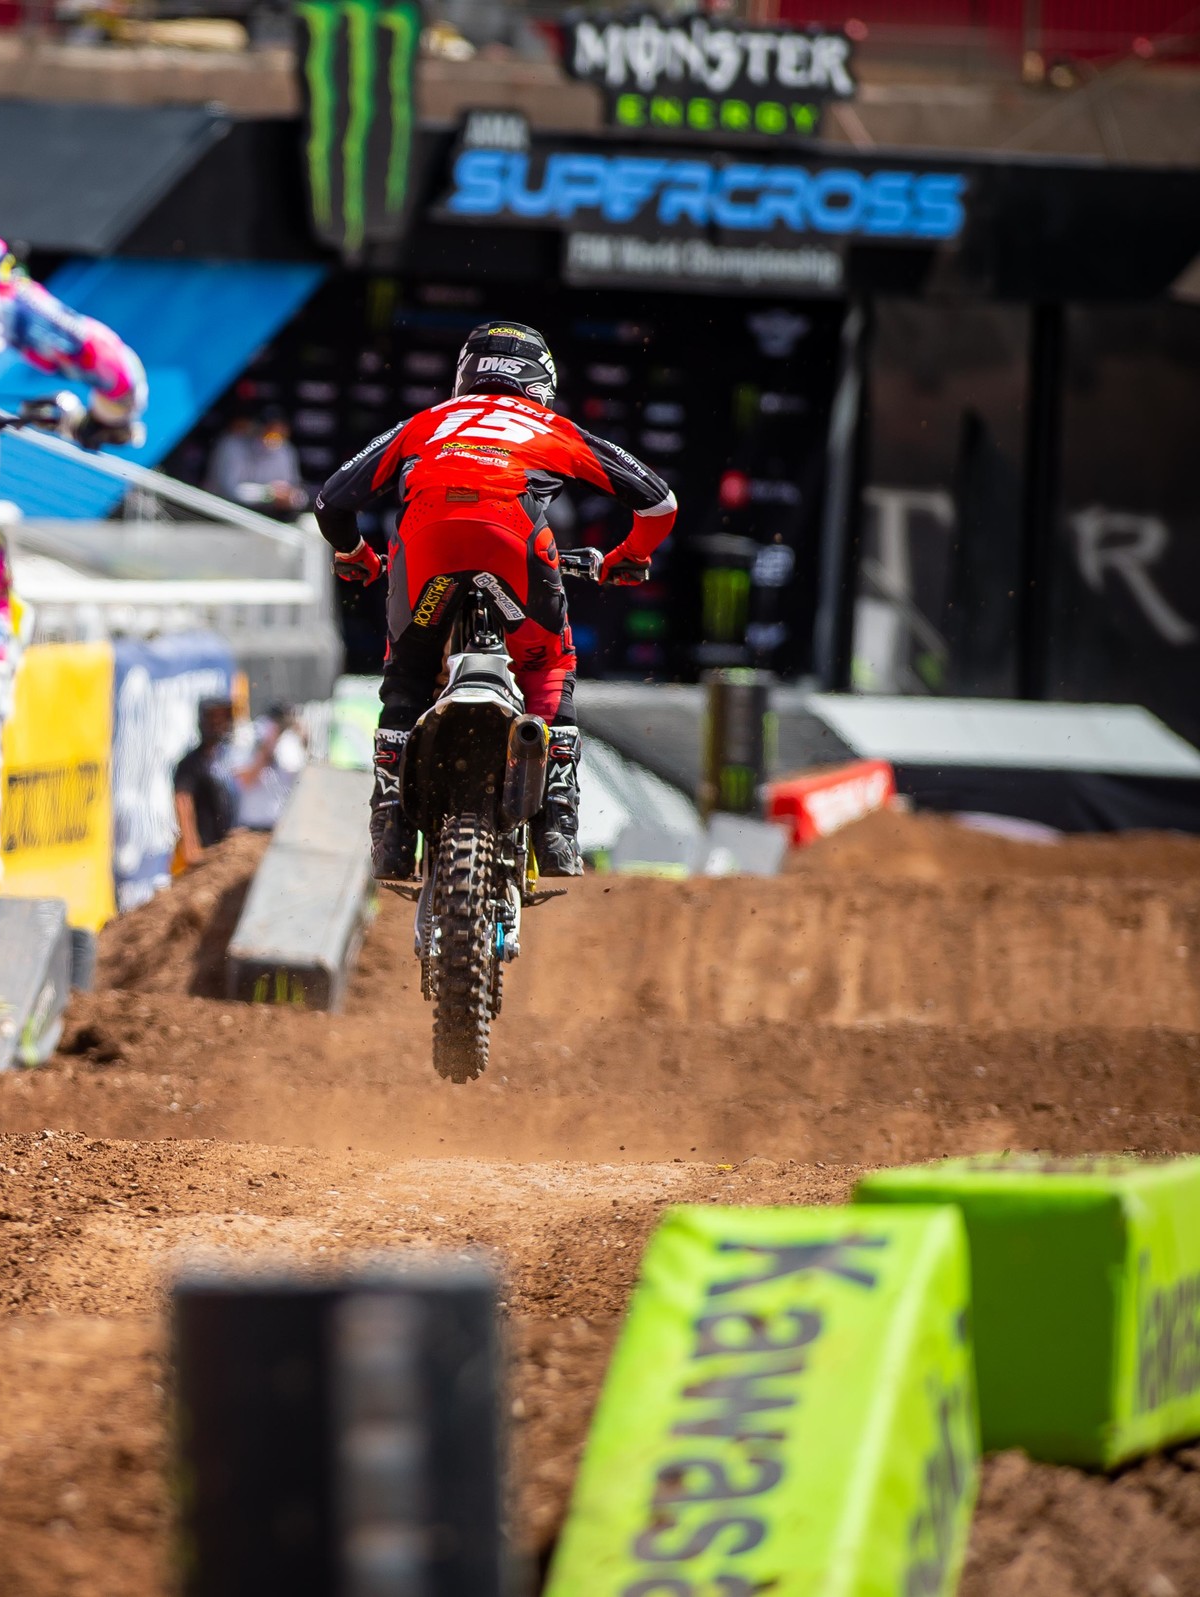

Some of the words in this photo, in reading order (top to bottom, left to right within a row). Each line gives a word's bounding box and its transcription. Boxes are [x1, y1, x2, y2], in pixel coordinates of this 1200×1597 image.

[574, 15, 853, 94] MONSTER
[616, 95, 818, 134] ENERGY
[450, 149, 966, 239] SUPERCROSS
[424, 407, 554, 444] 15
[413, 575, 453, 628] ROCKSTAR
